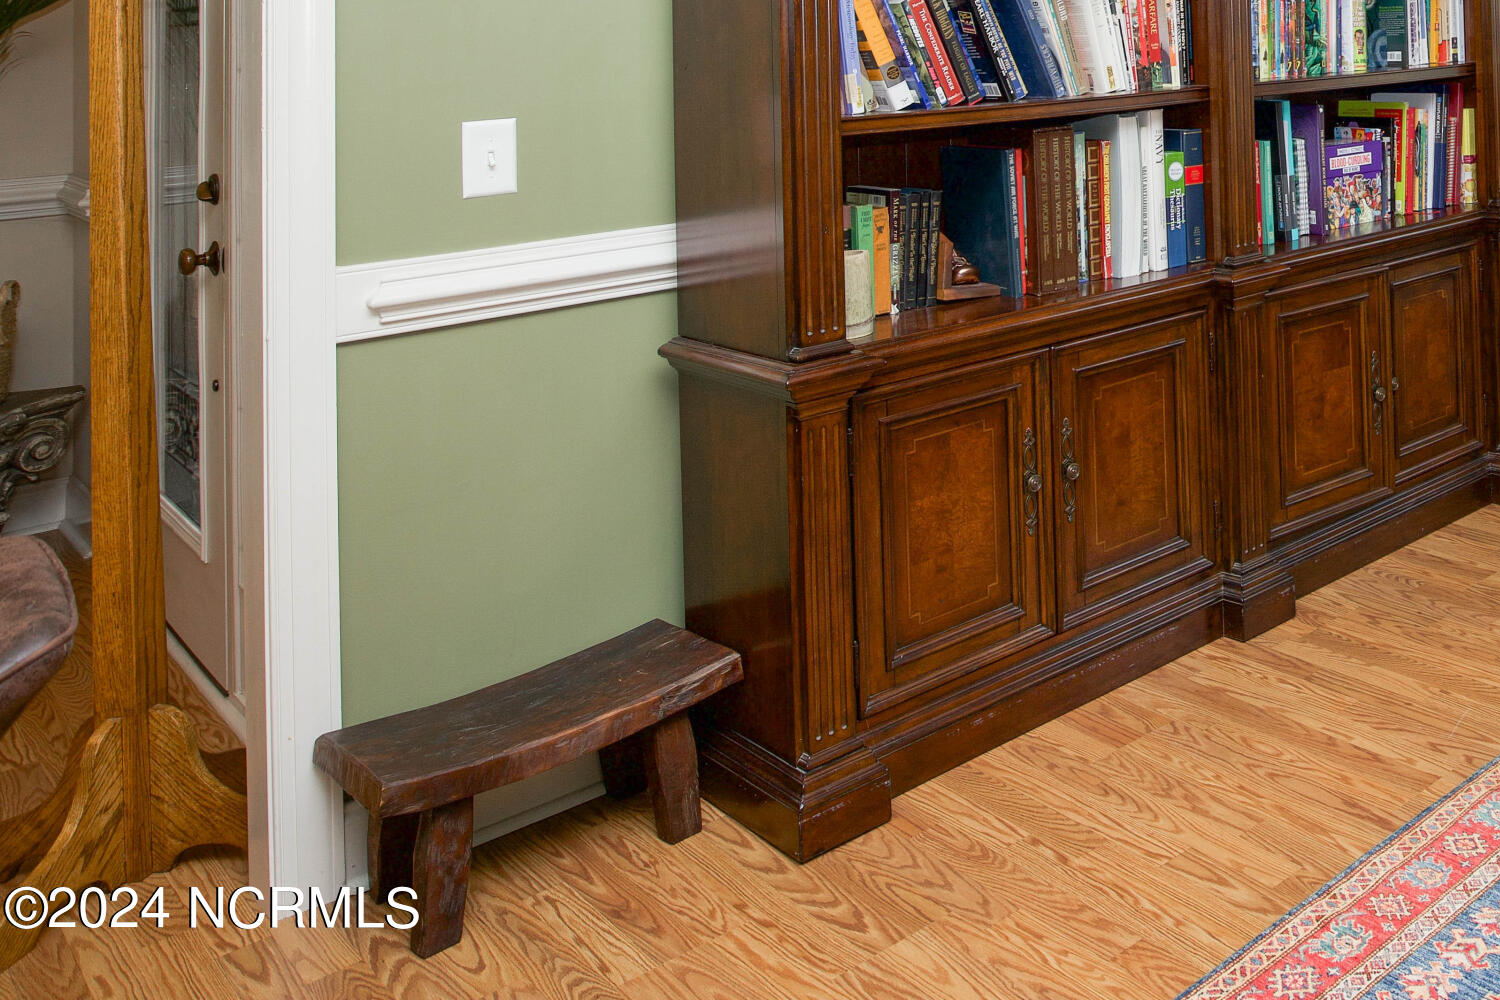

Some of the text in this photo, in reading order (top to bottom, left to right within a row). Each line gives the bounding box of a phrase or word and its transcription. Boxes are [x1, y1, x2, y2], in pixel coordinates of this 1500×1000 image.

[920, 8, 929, 22] THE
[896, 30, 913, 66] PEARL HARBOR
[924, 23, 944, 65] CONFEDERATE
[936, 9, 954, 40] HIGGINS
[952, 41, 961, 62] FLIGHT
[964, 72, 974, 92] EAGLES
[982, 20, 998, 54] HARBOR
[942, 66, 955, 91] READER
[1039, 45, 1064, 93] SHIPWRECKS
[1039, 139, 1047, 172] HISTORY
[1052, 138, 1060, 170] HISTORY
[1063, 136, 1071, 169] HISTORY
[1155, 135, 1163, 164] NAVY
[1041, 173, 1048, 183] OF
[1053, 172, 1060, 182] OF
[1065, 170, 1071, 180] OF
[1065, 200, 1073, 229] WORLD
